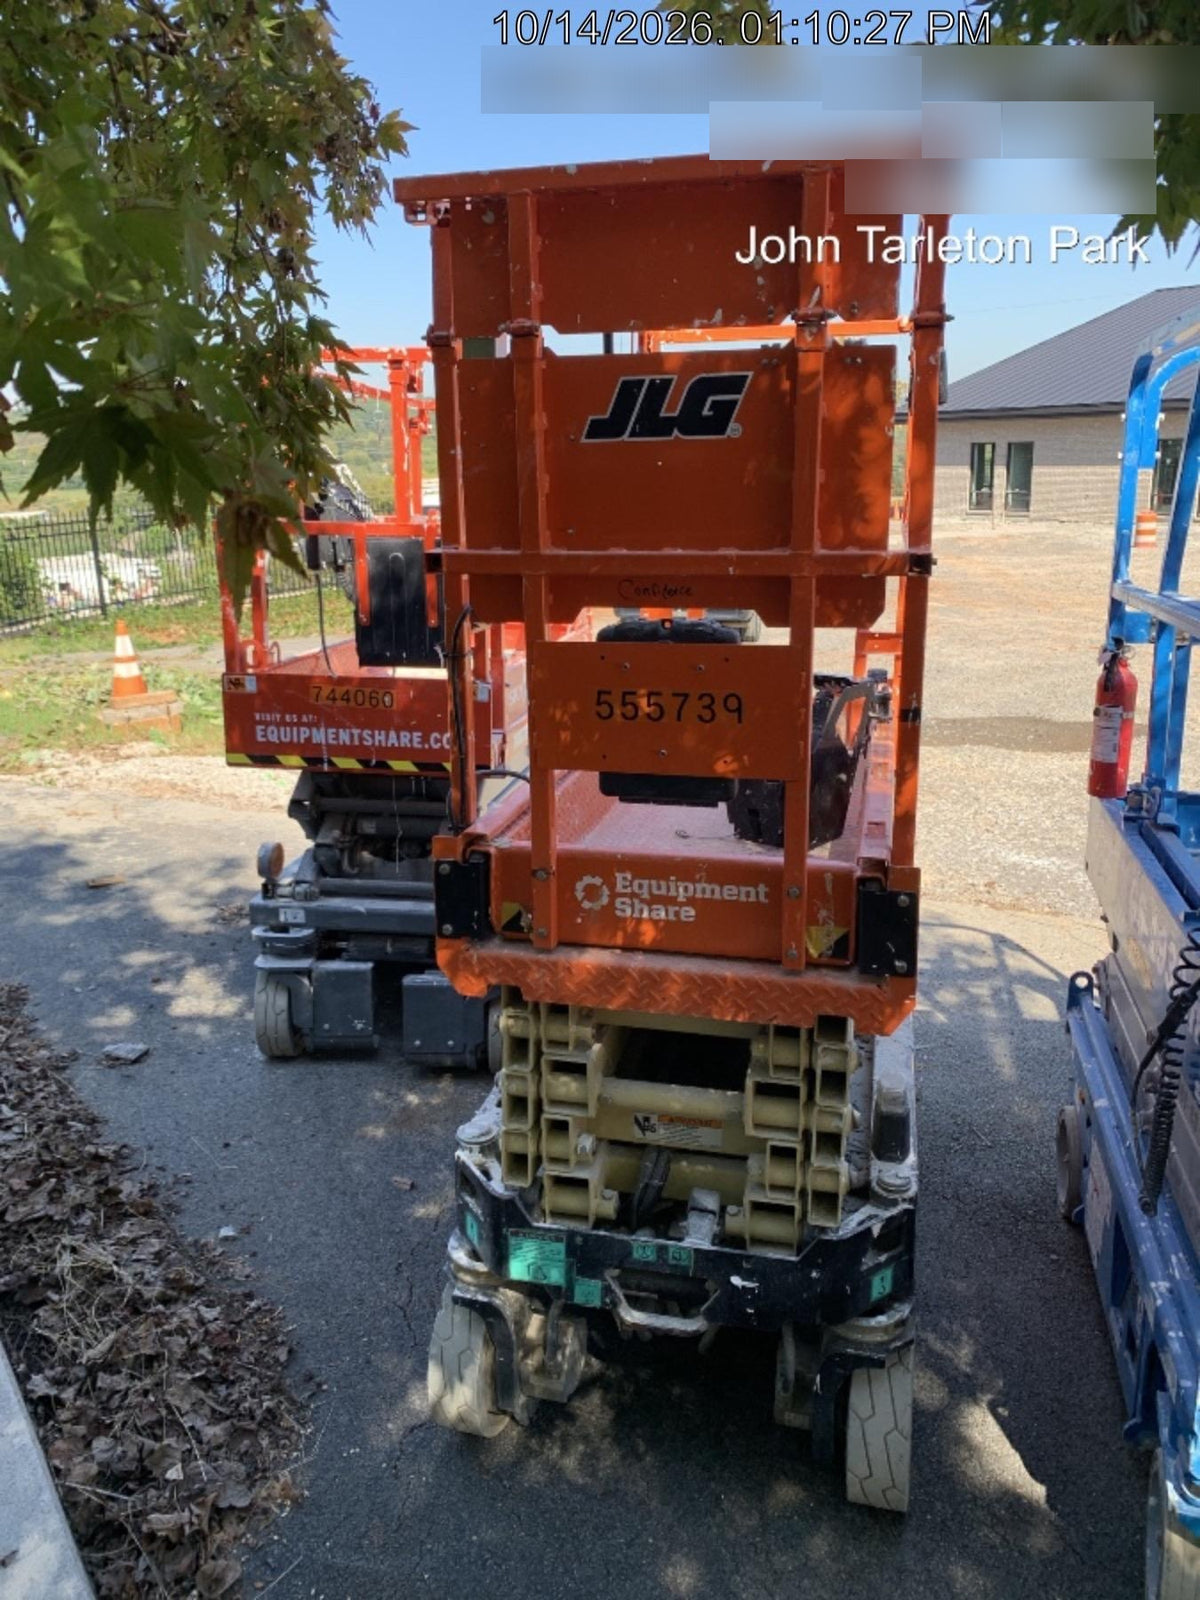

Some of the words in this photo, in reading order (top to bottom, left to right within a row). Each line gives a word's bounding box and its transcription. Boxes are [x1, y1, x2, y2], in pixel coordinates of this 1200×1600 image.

[580, 371, 754, 442] JLG
[312, 685, 395, 709] 744060
[595, 689, 744, 725] 555739
[615, 872, 769, 903] Equipment
[615, 897, 696, 922] Share
